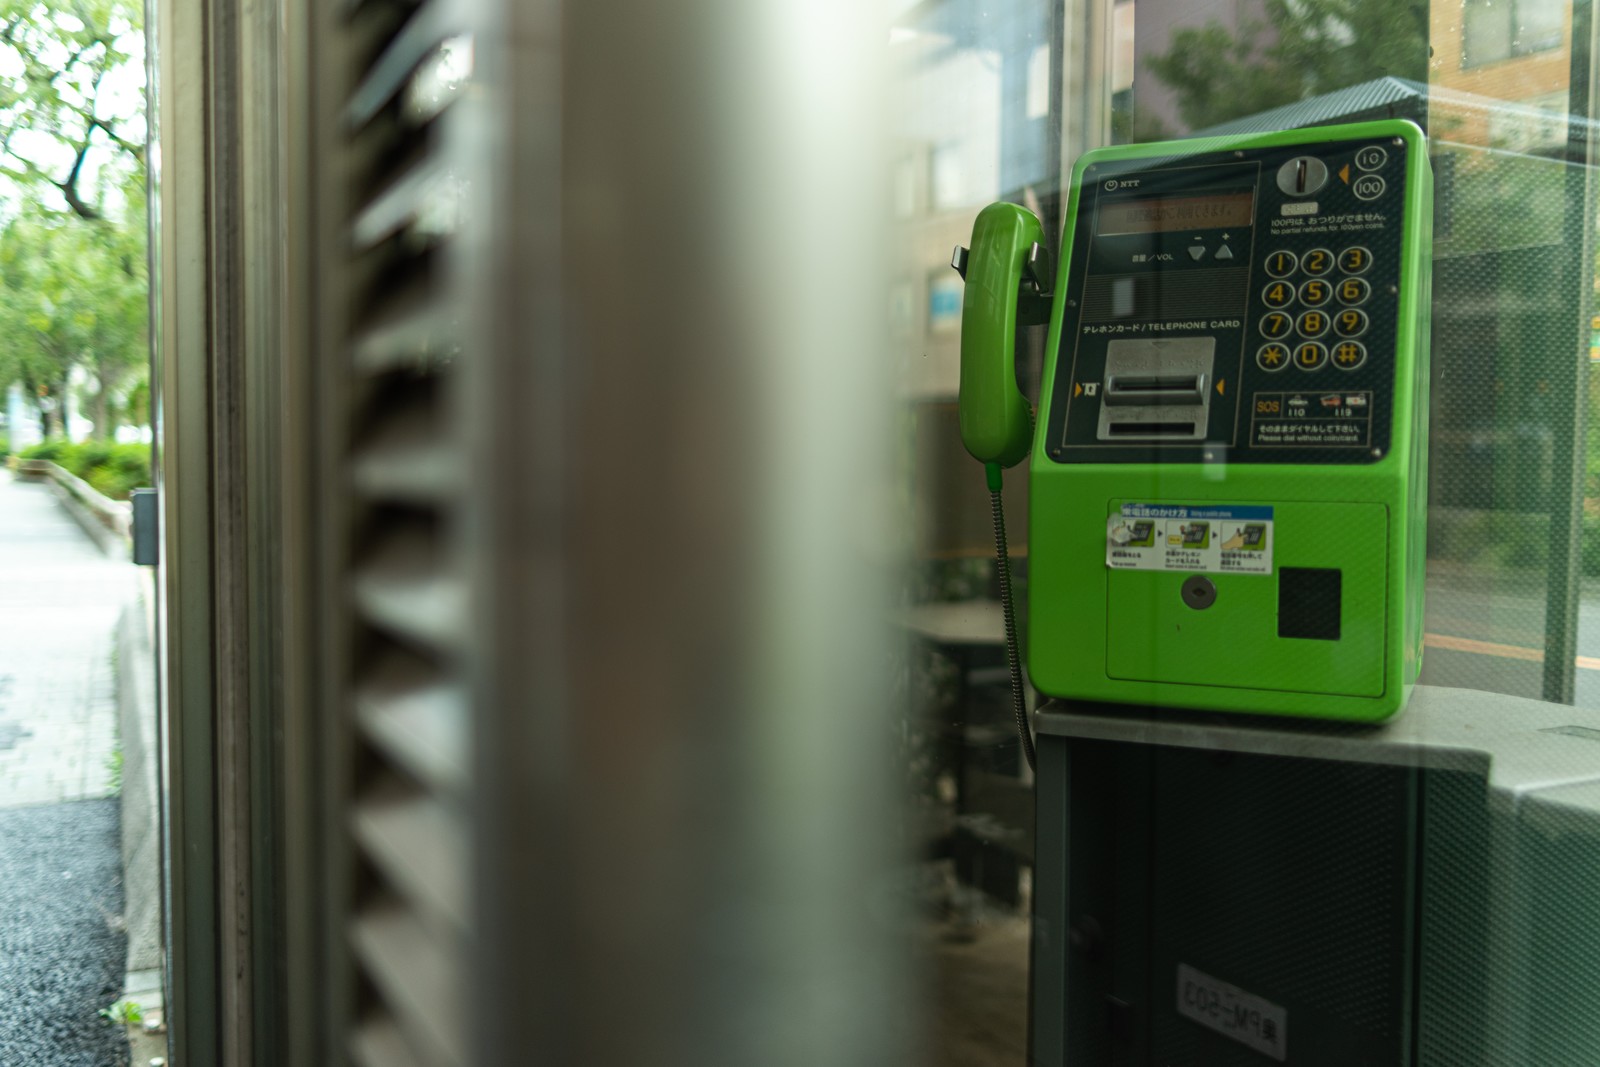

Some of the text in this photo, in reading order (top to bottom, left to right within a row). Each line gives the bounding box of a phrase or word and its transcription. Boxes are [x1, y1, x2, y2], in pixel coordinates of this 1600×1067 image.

[1361, 152, 1380, 165] 10
[1120, 180, 1140, 188] NTT
[1358, 181, 1381, 195] 100
[1281, 227, 1301, 236] partial
[1303, 225, 1327, 233] refunds
[1157, 253, 1173, 261] VOL
[1277, 253, 1284, 271] 1
[1310, 251, 1325, 271] 2
[1348, 249, 1362, 268] 3
[1269, 284, 1284, 302] 4
[1308, 282, 1322, 300] 5
[1343, 281, 1359, 299] 6
[1083, 324, 1139, 334] テレホンカード
[1149, 321, 1207, 331] TELEPHONE
[1210, 320, 1240, 328] CARD
[1270, 315, 1283, 333] 7
[1304, 313, 1320, 332] 8
[1342, 312, 1358, 331] 9
[1302, 345, 1318, 364] 0
[1257, 400, 1280, 413] SOS
[1288, 408, 1306, 417] 110
[1334, 408, 1353, 417] 119
[1258, 434, 1282, 442] Please
[1283, 434, 1296, 442] dial
[1297, 434, 1322, 442] without
